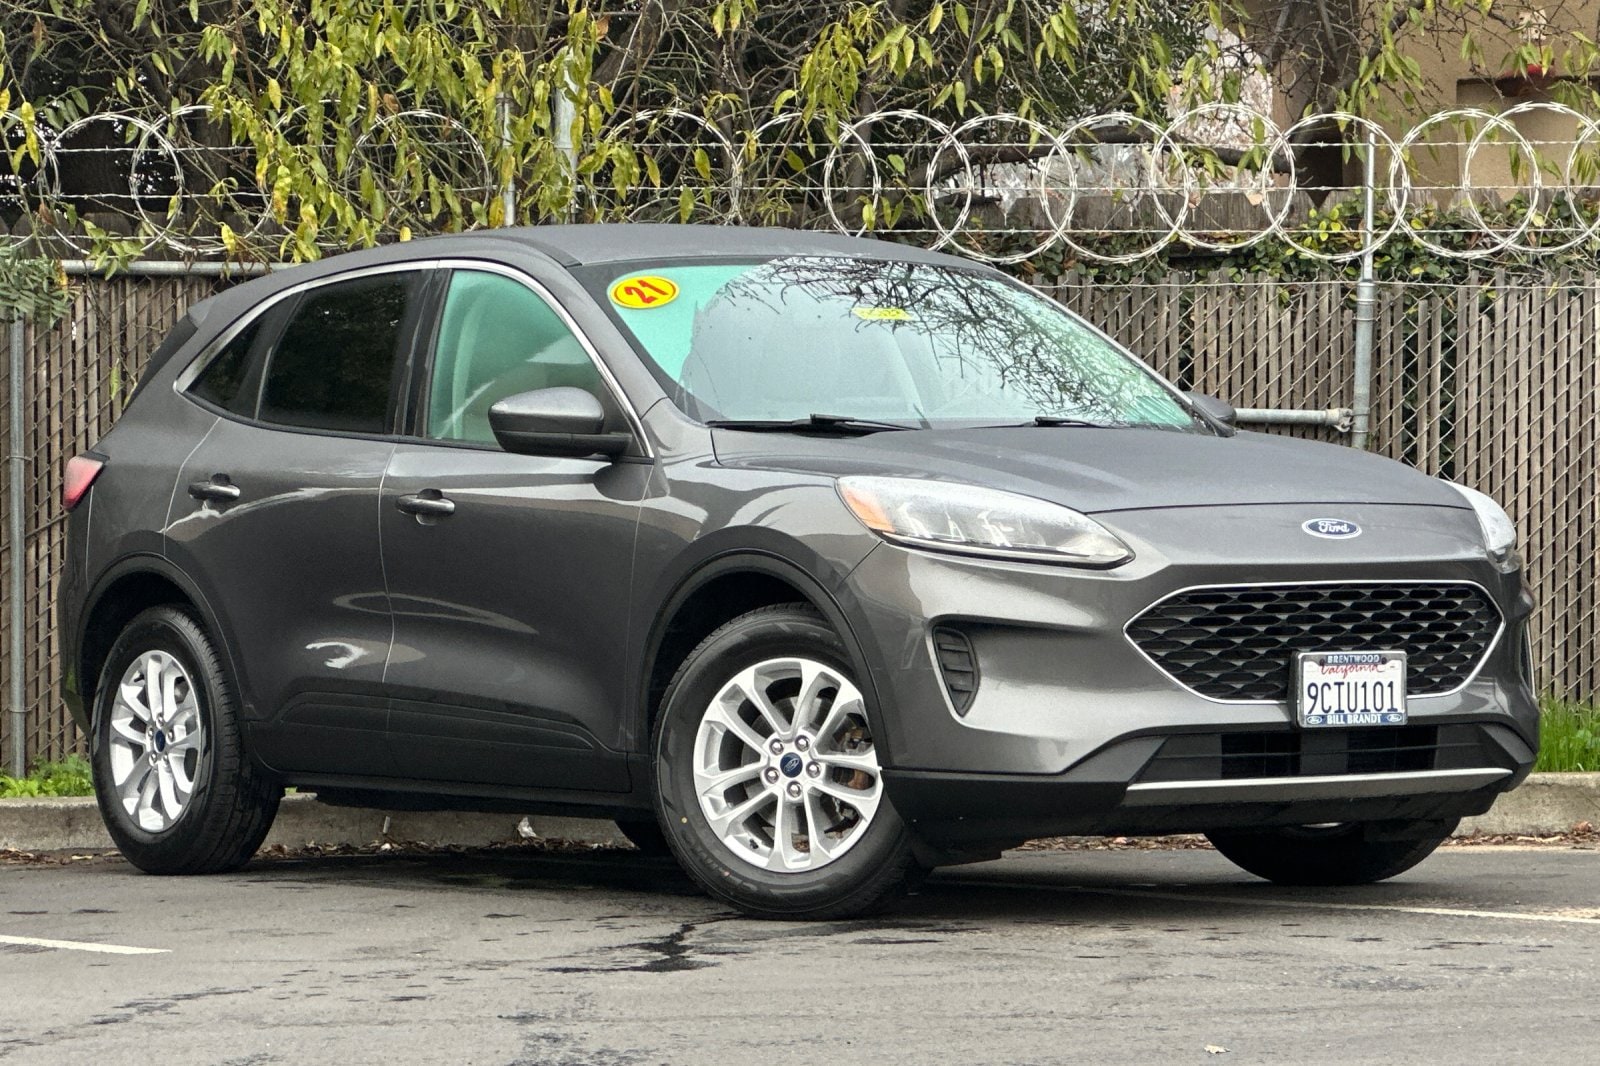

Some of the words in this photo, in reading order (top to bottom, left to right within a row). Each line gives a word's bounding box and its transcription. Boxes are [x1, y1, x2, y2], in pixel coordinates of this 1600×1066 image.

[624, 279, 669, 304] 21
[1318, 520, 1350, 533] Ford
[1327, 654, 1380, 664] BRENTWOOD
[1320, 663, 1385, 679] California
[1307, 680, 1398, 715] 9CIU101
[1326, 714, 1346, 725] BILL
[1347, 713, 1382, 724] BRANDT
